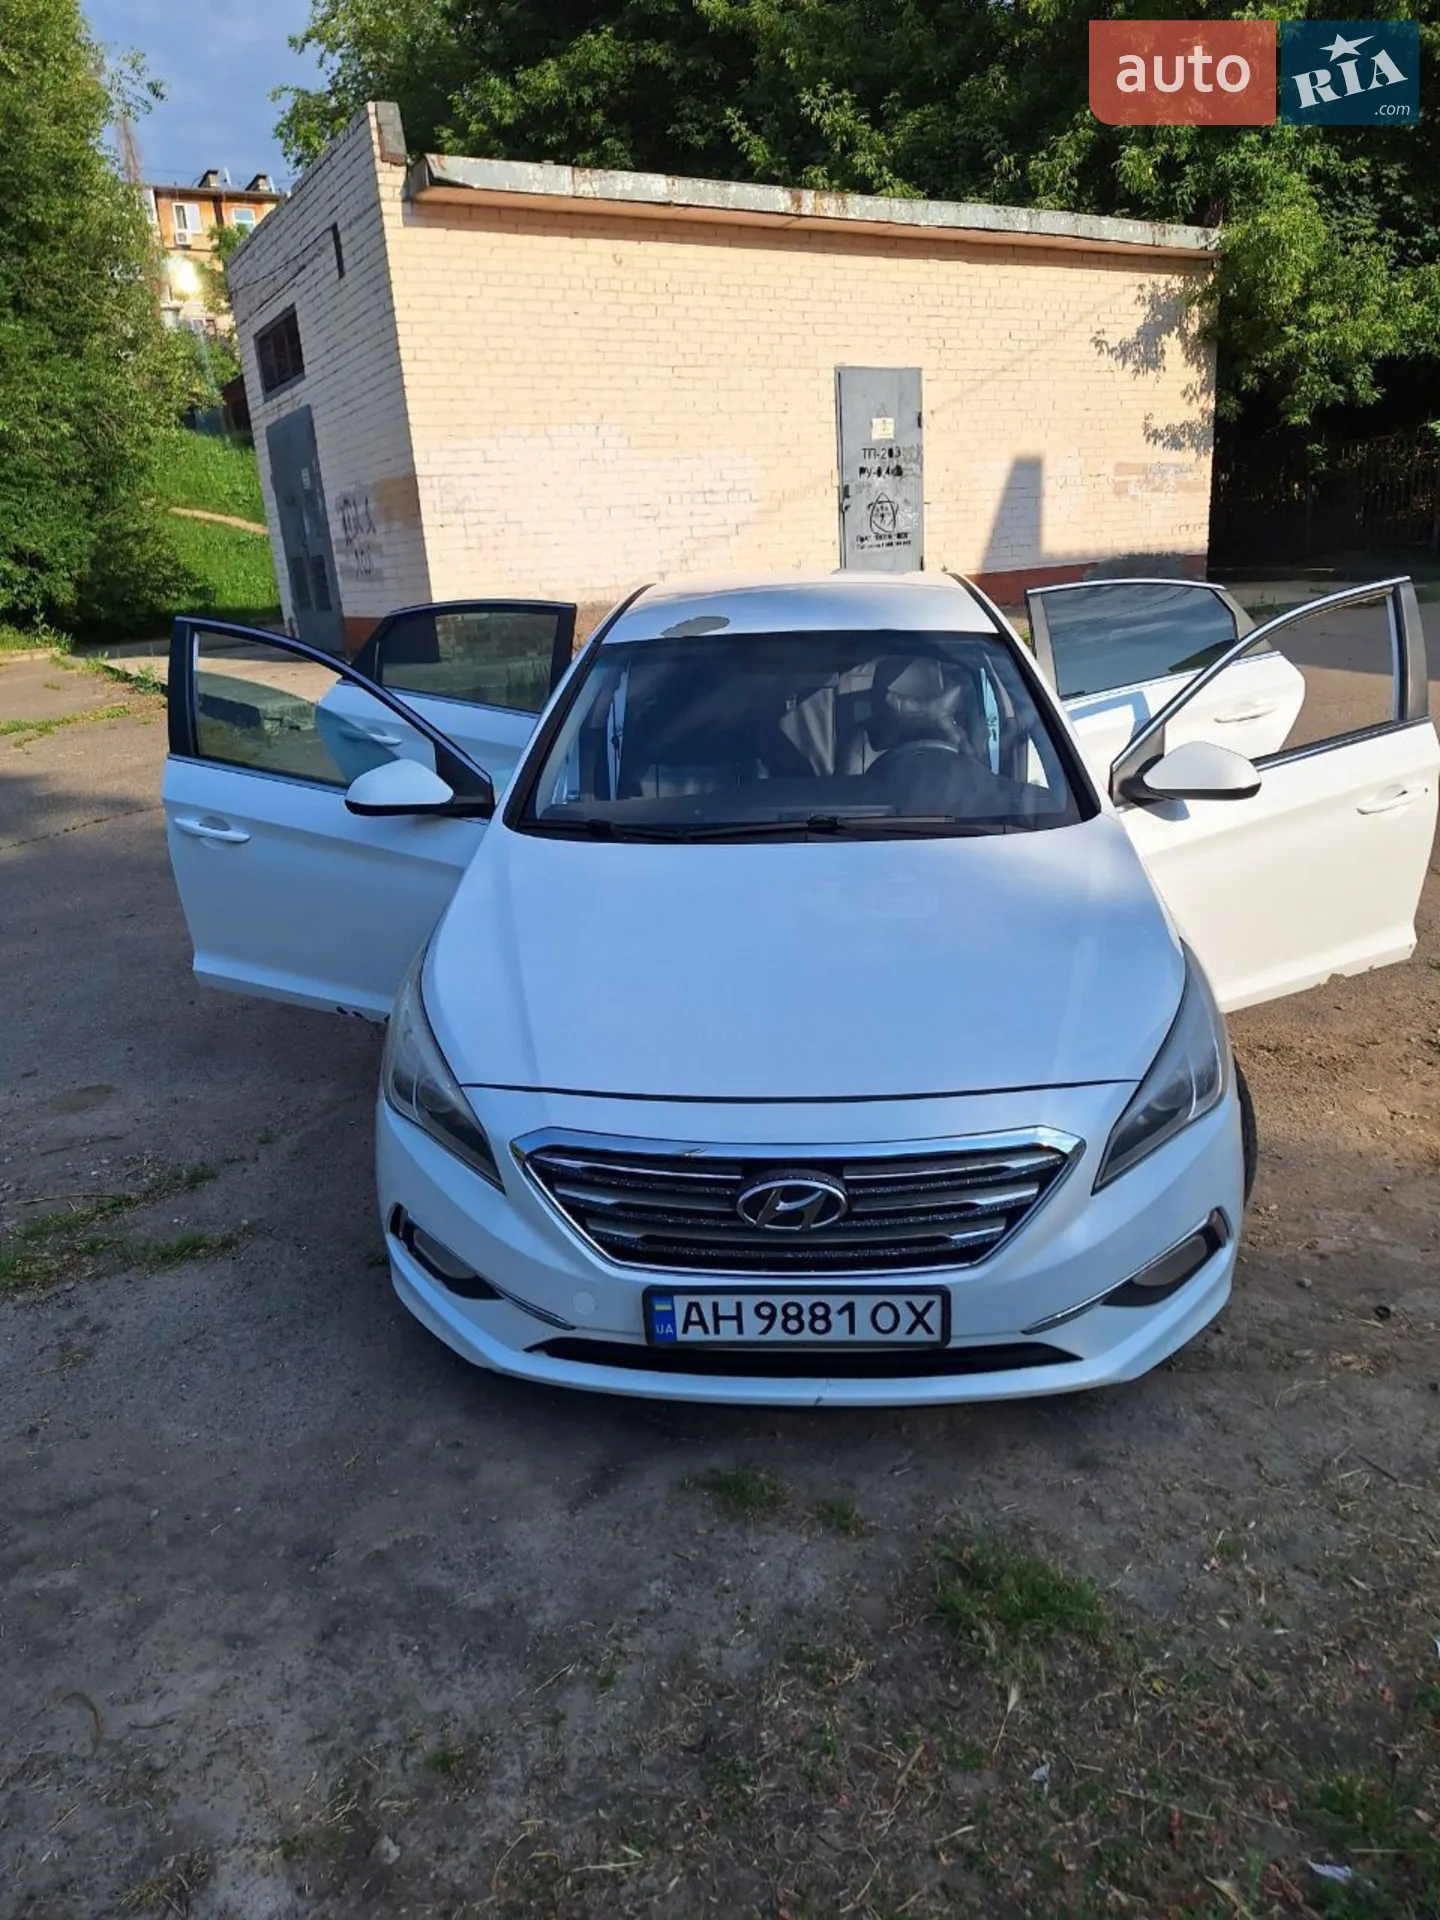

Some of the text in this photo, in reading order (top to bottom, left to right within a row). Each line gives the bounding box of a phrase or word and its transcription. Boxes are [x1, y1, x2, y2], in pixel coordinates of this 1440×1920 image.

[655, 1323, 674, 1335] UA
[681, 1301, 935, 1335] AH 9881 OX
